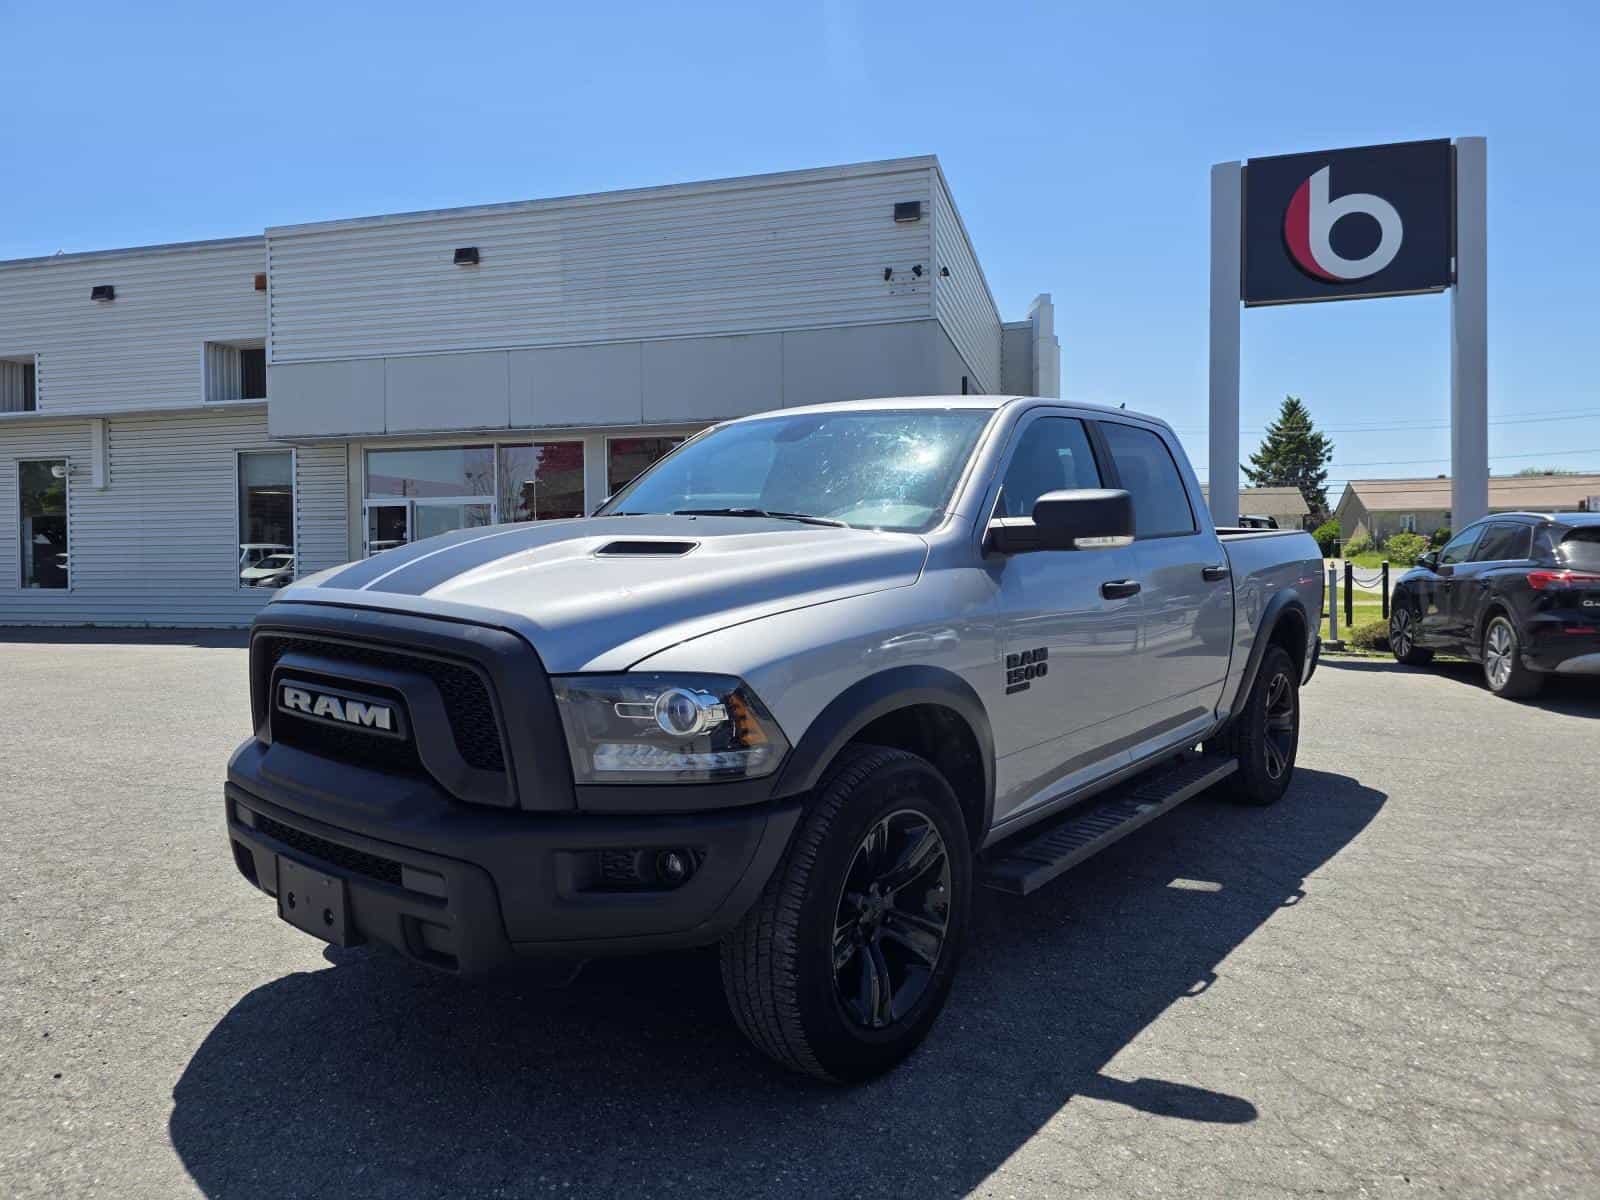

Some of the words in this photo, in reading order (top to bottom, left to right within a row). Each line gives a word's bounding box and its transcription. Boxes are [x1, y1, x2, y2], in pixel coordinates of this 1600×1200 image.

[1307, 163, 1404, 281] b
[1006, 646, 1049, 669] RAM
[1006, 663, 1049, 685] 1500
[283, 686, 391, 730] RAM
